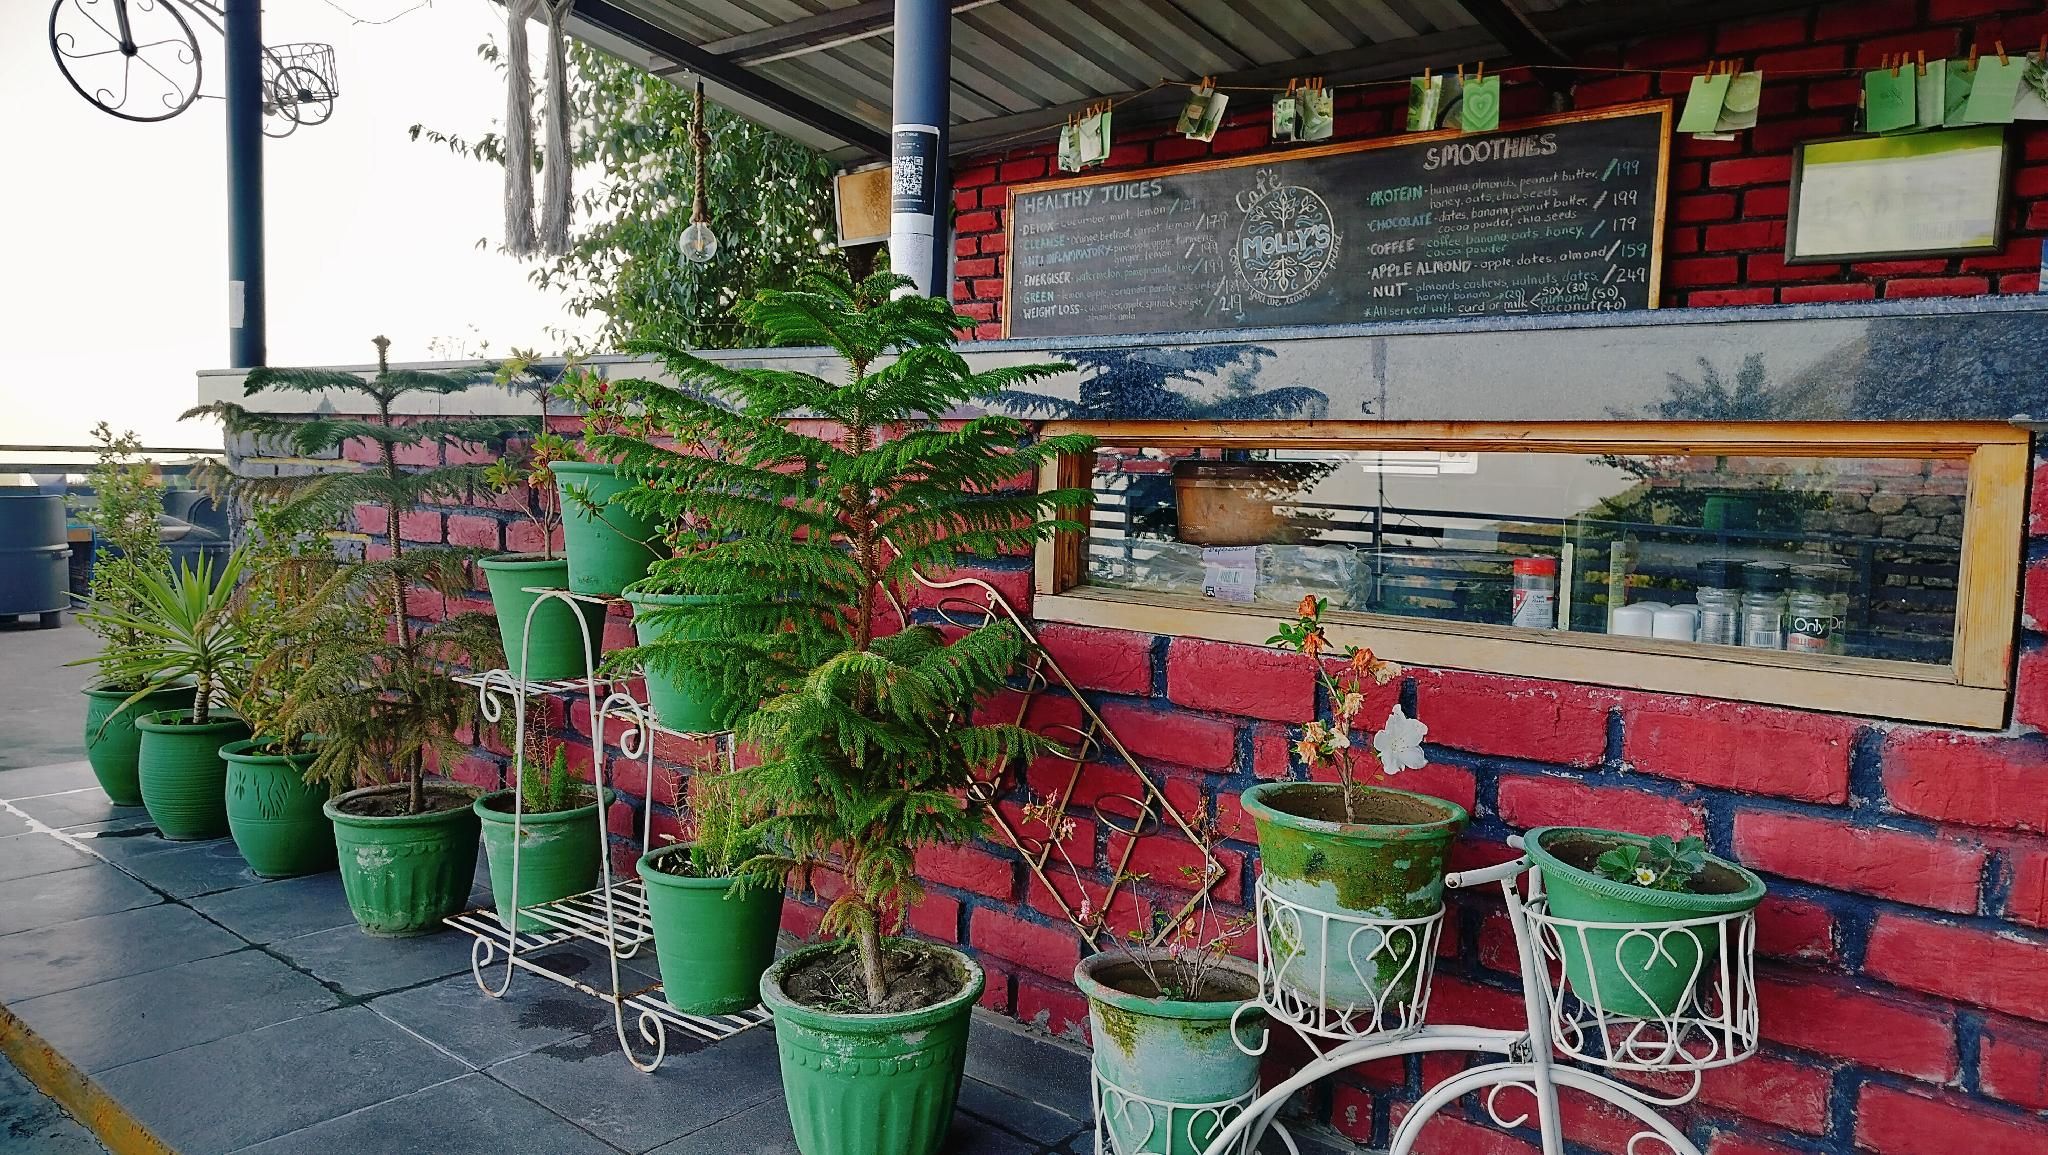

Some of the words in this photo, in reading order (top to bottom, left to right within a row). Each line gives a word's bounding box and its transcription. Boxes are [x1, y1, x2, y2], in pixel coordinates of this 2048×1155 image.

[1423, 133, 1557, 170] SMOOTHIES
[1520, 171, 1557, 193] peanut
[1025, 187, 1094, 214] HEALTHY
[1101, 179, 1162, 204] JUICES
[1496, 189, 1520, 201] chia
[1523, 186, 1559, 199] seeds
[1138, 206, 1166, 217] lemon
[1511, 200, 1551, 219] peanut
[1166, 220, 1195, 230] lemon
[1438, 223, 1470, 234] cocoa
[1517, 214, 1541, 225] chia
[1544, 210, 1578, 223] seeds
[1242, 223, 1331, 259] MOLLY'S
[1370, 238, 1416, 256] COFFEE
[1426, 248, 1461, 258] cocoa
[1465, 243, 1507, 259] powder
[1371, 261, 1413, 280] APPLE
[1415, 259, 1472, 276] ALMOND
[1559, 245, 1607, 261] almond
[1023, 291, 1054, 304] GREEN
[1453, 291, 1491, 301] banana
[1540, 286, 1591, 304] almond
[1592, 284, 1619, 301] (50)
[1541, 285, 1564, 297] soy
[1023, 303, 1058, 320] WEIGHT
[1389, 303, 1427, 316] served
[1431, 302, 1454, 314] with
[1458, 301, 1485, 314] curd
[1488, 301, 1500, 311] or
[1503, 296, 1529, 310] milk
[1540, 298, 1598, 313] coconut
